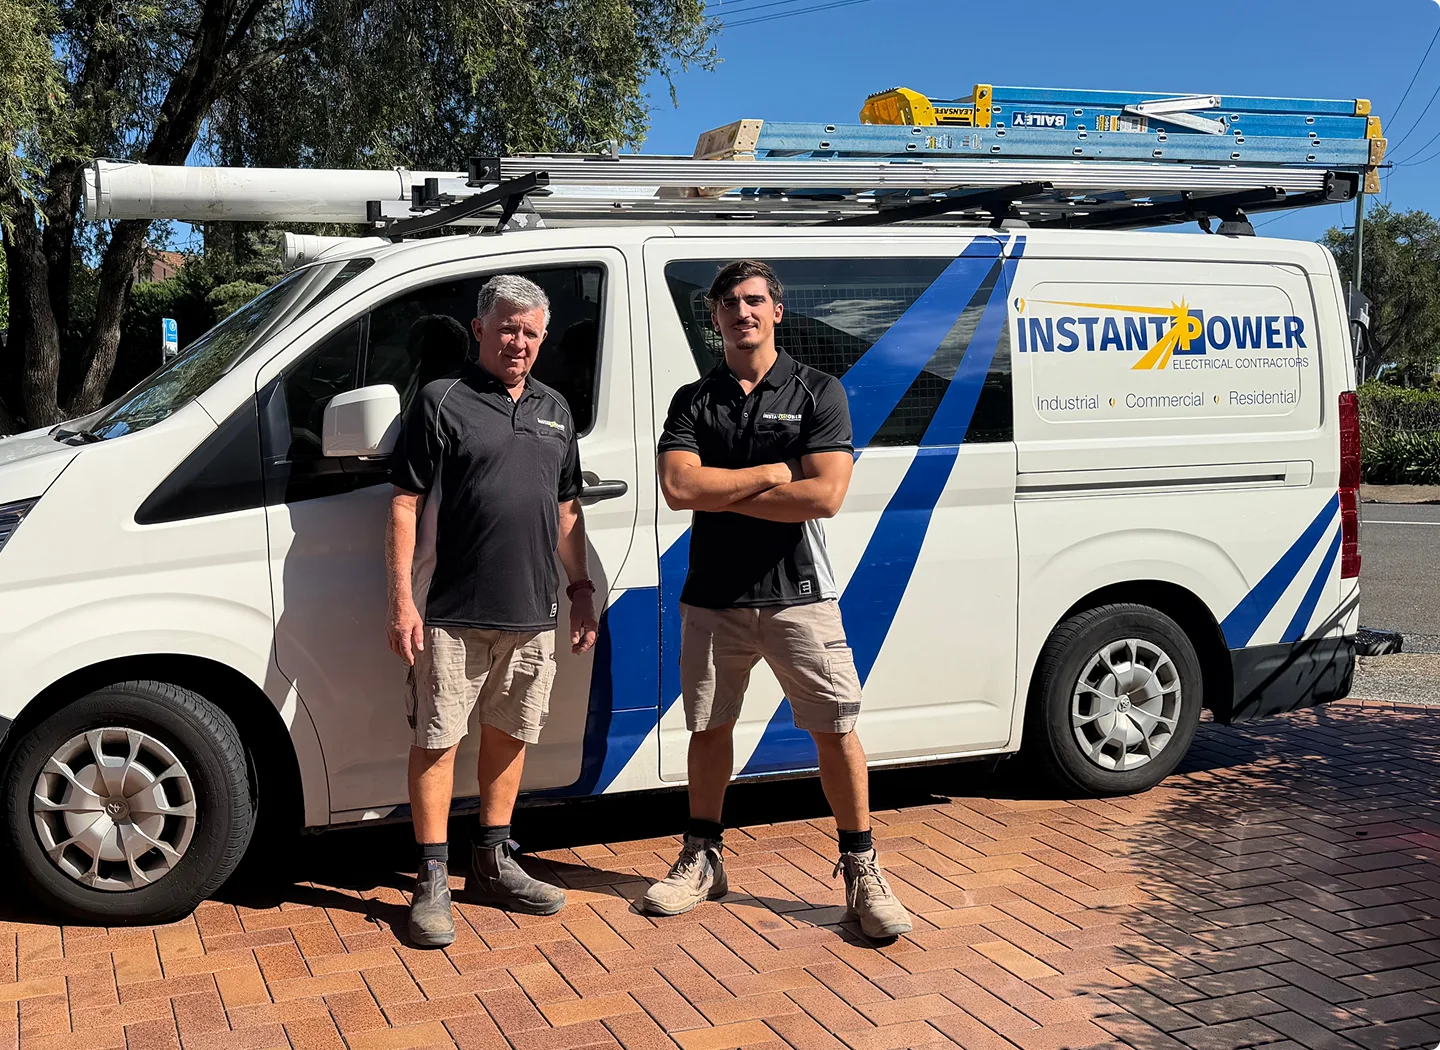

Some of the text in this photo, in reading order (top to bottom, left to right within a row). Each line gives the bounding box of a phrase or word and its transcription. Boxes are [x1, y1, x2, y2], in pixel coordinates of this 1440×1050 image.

[934, 107, 973, 115] LEANSAFE
[1014, 114, 1065, 126] BAILEY
[1017, 315, 1307, 353] INSTANT POWER
[1173, 357, 1309, 370] ELECTRICAL CONTRACTORS
[1037, 389, 1297, 411] Industrial Commercial Residential
